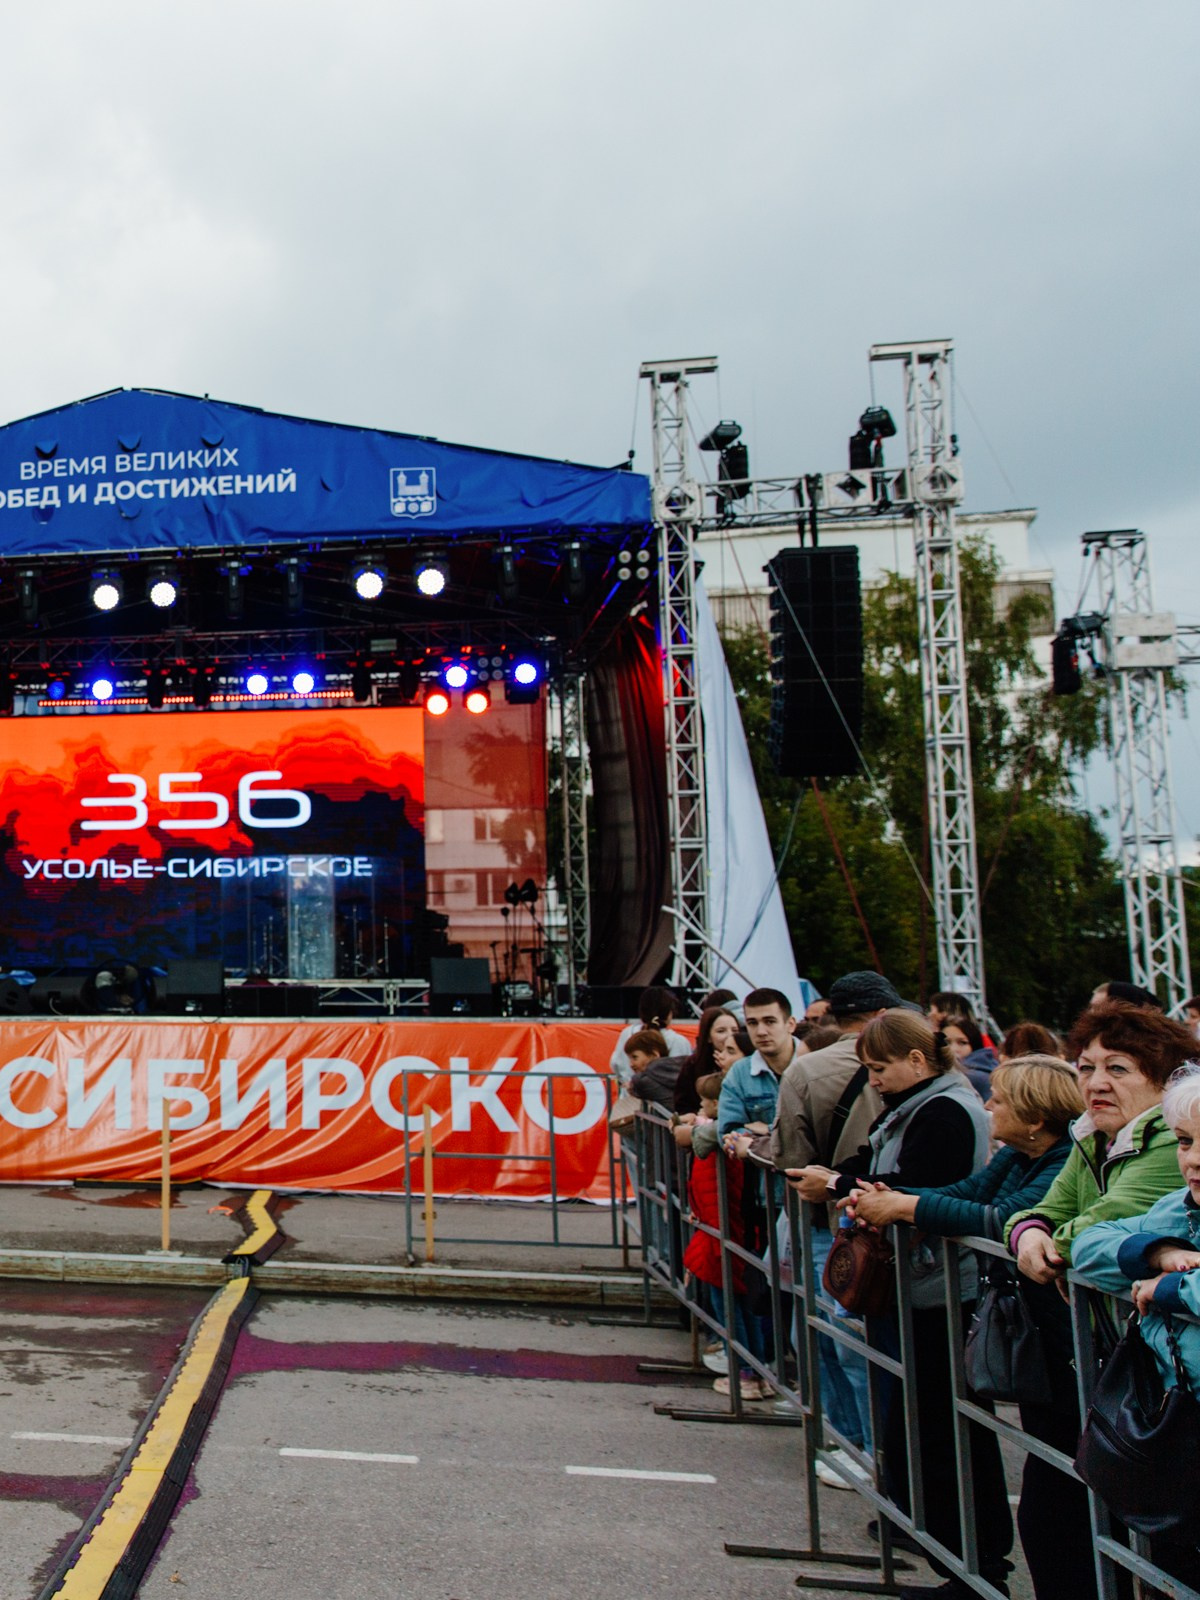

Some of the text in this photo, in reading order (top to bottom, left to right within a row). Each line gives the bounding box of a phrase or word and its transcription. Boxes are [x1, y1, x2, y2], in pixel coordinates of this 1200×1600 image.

[20, 448, 239, 480] ВРЕМЯ ВЕЛИКИХ
[68, 484, 87, 503] И
[94, 468, 297, 505] ДОСТИЖЕНИЙ
[80, 771, 312, 831] 356
[23, 857, 373, 879] УСОЛЬЕ-СИБИРСКОЕ
